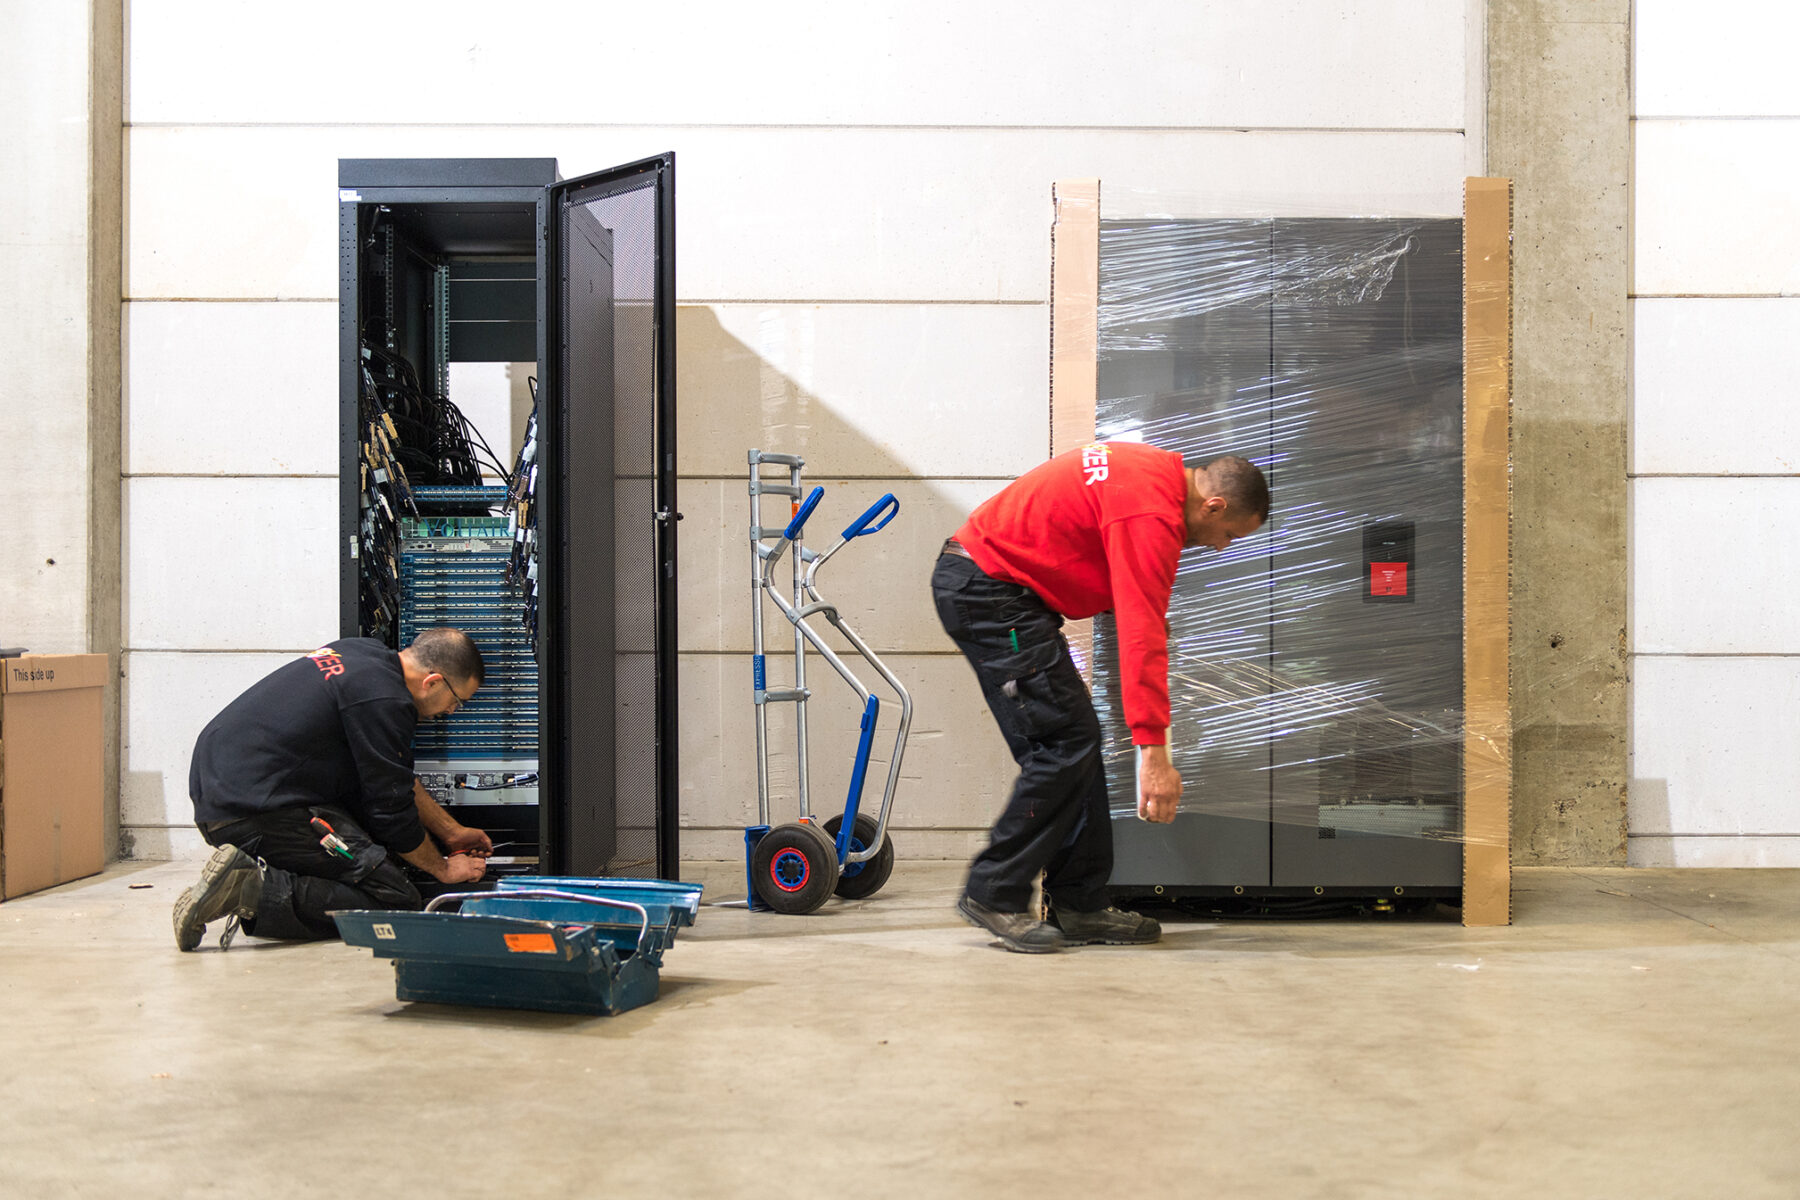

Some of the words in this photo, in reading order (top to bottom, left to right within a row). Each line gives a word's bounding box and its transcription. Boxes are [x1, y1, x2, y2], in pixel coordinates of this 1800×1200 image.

[13, 668, 29, 681] This
[30, 668, 44, 681] side
[45, 669, 55, 682] up
